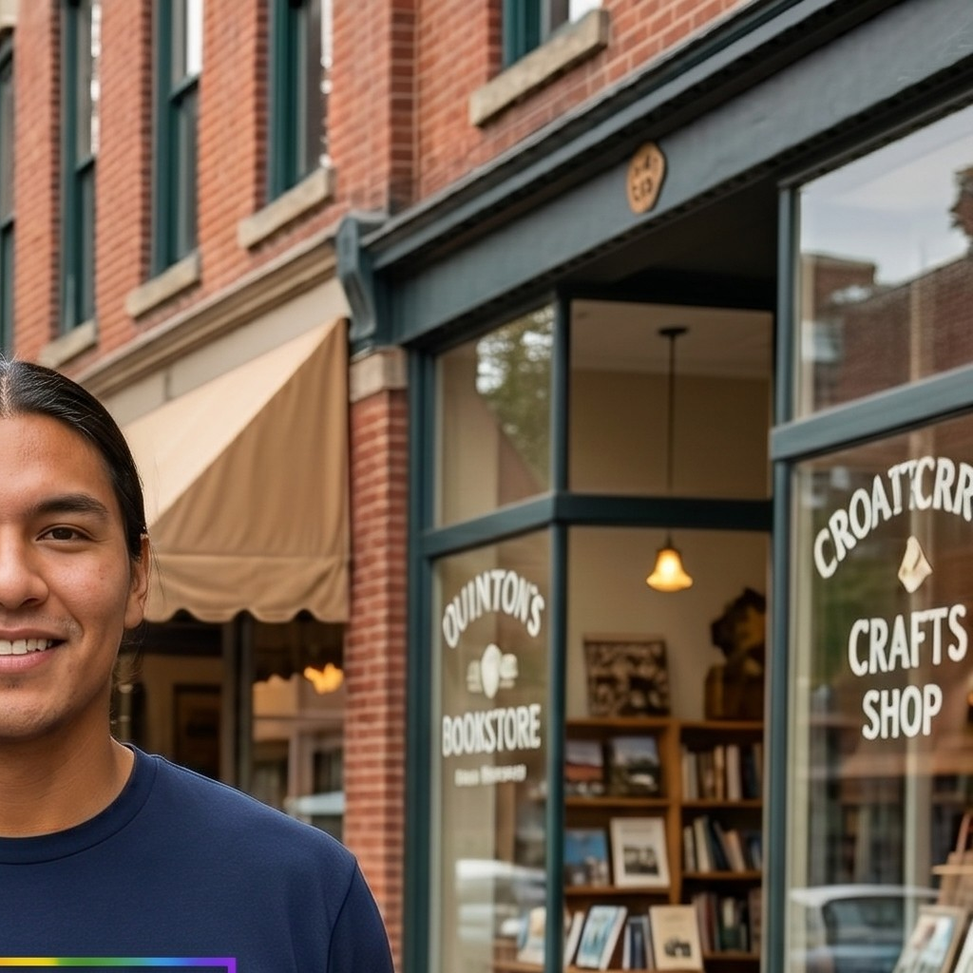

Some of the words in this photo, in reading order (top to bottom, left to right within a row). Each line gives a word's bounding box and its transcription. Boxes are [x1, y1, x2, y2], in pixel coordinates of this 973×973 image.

[848, 604, 968, 677] CRAFTS
[442, 703, 541, 758] BOOKSTORE
[862, 683, 943, 740] SHOP
